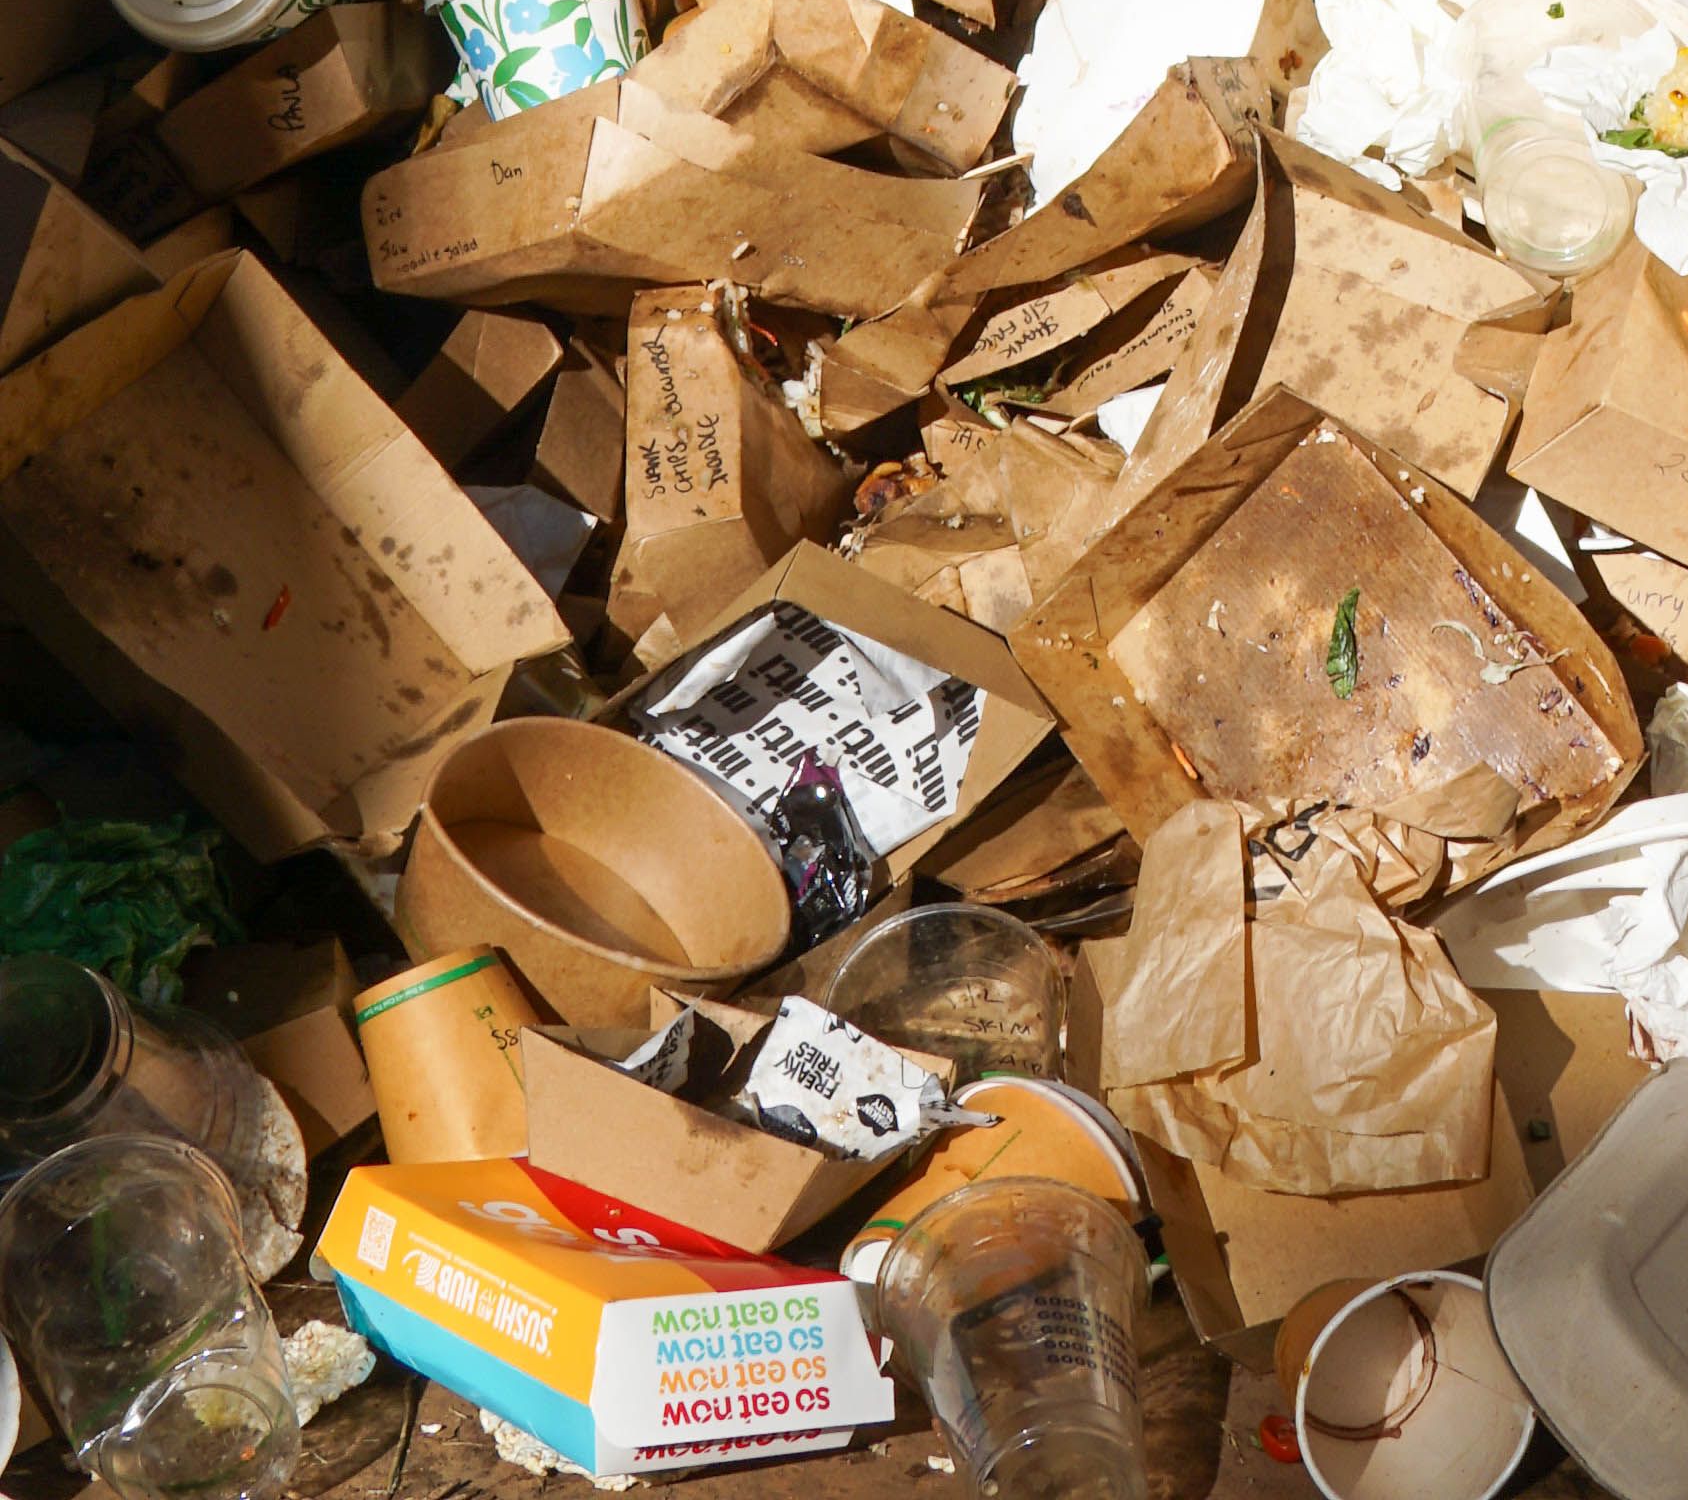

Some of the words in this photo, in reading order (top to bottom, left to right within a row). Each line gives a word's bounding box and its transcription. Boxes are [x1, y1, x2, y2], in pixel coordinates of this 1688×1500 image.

[490, 159, 524, 186] Dan
[773, 1048, 842, 1101] FREAKY
[795, 1041, 842, 1080] FRIES
[436, 1264, 480, 1316] HUB
[493, 1294, 553, 1356] SUSHI
[652, 1305, 722, 1335] now
[726, 1300, 779, 1333] eat
[783, 1296, 821, 1323] so
[655, 1334, 727, 1365] now
[729, 1329, 783, 1363] eat
[788, 1325, 825, 1351] so
[658, 1364, 730, 1396] now
[733, 1359, 787, 1393] eat
[791, 1355, 828, 1381] so
[661, 1395, 733, 1427] now
[737, 1390, 790, 1424] eat
[795, 1386, 831, 1412] so
